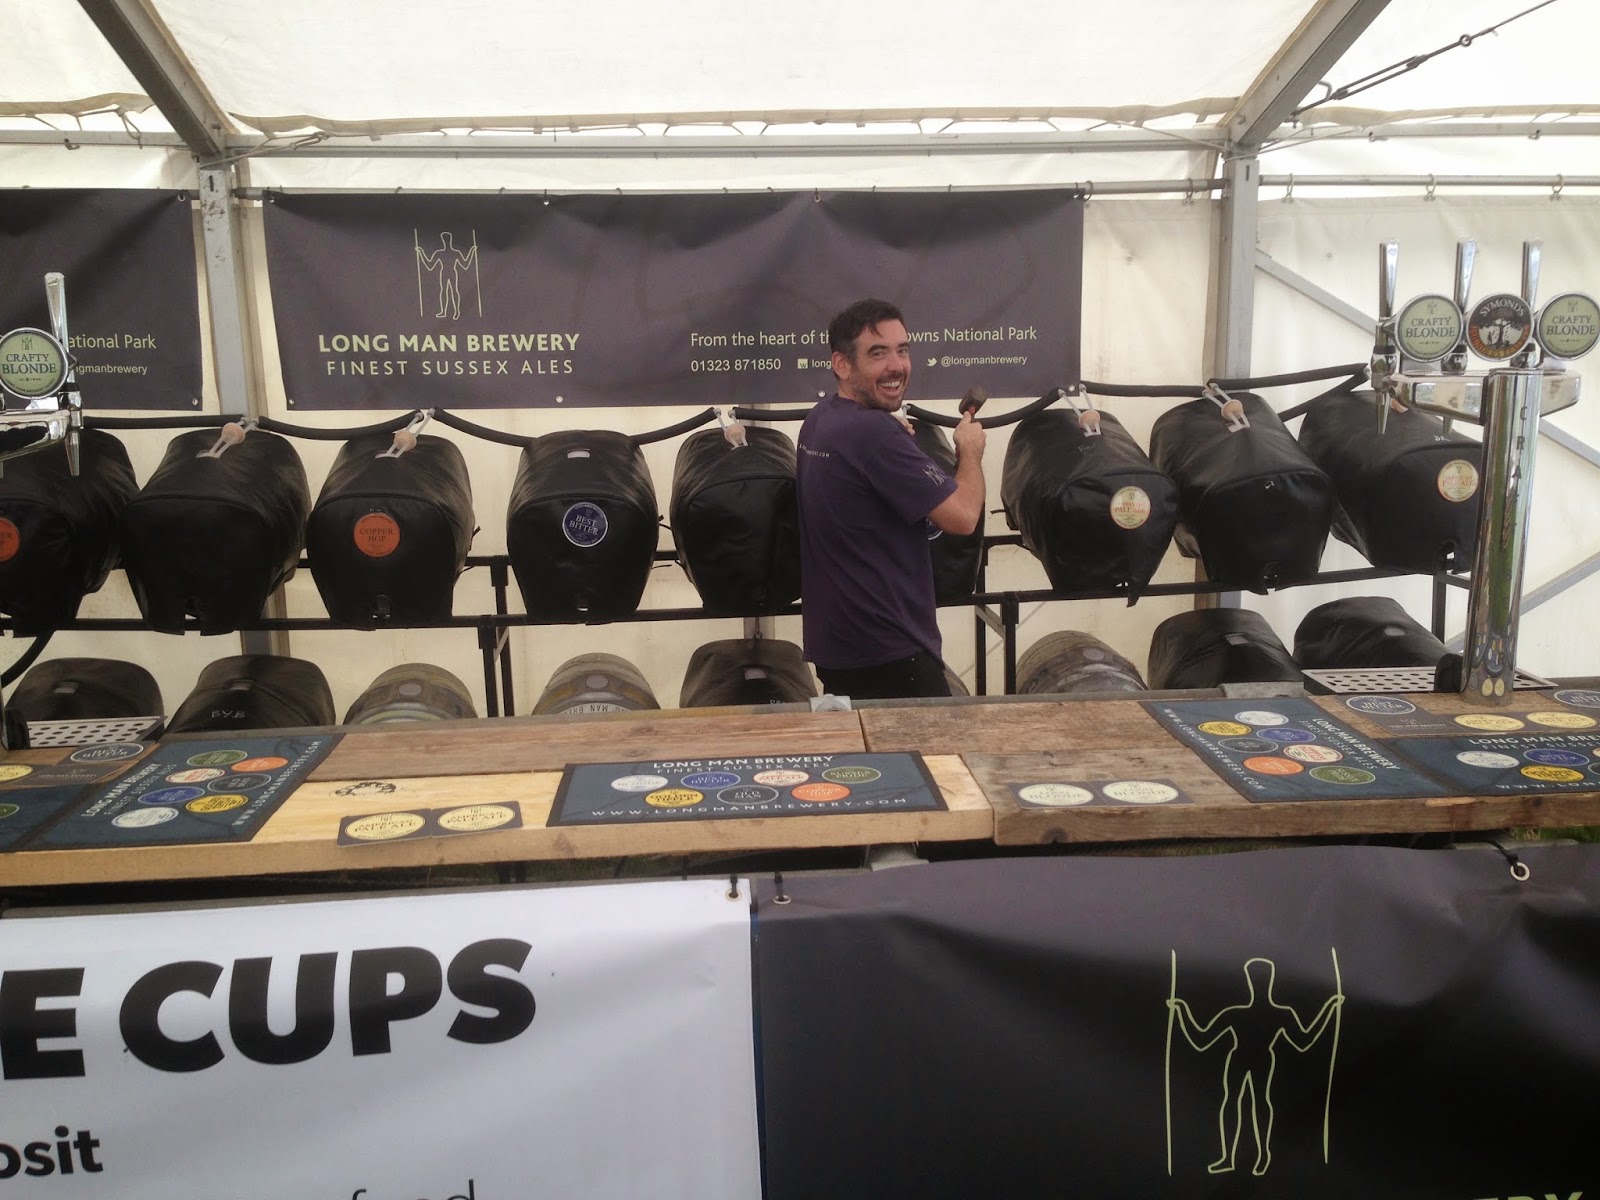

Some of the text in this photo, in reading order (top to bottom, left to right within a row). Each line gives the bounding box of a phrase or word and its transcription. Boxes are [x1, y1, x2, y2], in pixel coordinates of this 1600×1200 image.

[1480, 299, 1525, 317] SYMONDS
[1411, 317, 1452, 327] CRAFTY
[1552, 315, 1592, 324] CRAFTY
[691, 333, 727, 347] From
[732, 331, 755, 346] the
[759, 331, 797, 345] heart
[801, 330, 816, 344] of
[907, 331, 939, 342] owns
[944, 327, 1004, 342] National
[1008, 326, 1037, 340] Park
[1405, 327, 1455, 338] BLONDE
[1546, 325, 1596, 336] BLONDE
[69, 333, 157, 349] ational Park
[318, 333, 580, 353] LONG MAN BREWERY
[6, 353, 50, 362] CRAFTY
[691, 355, 1028, 372] 01323 871850 long @longmanbrewery
[2, 363, 57, 374] BLONDE
[327, 359, 573, 376] FINEST SUSSEX ALES
[569, 520, 599, 535] BITTER
[576, 514, 597, 527] BEST
[1312, 718, 1400, 769] LONG MAN BREWERY
[1468, 737, 1519, 745] LONG
[1522, 735, 1564, 743] MAN
[653, 755, 834, 769] LONG MAN BREWERY
[657, 766, 713, 774] FINEST
[592, 798, 907, 816] WWW.LONGMANBREWERY.COM
[119, 937, 537, 1074] CUPS
